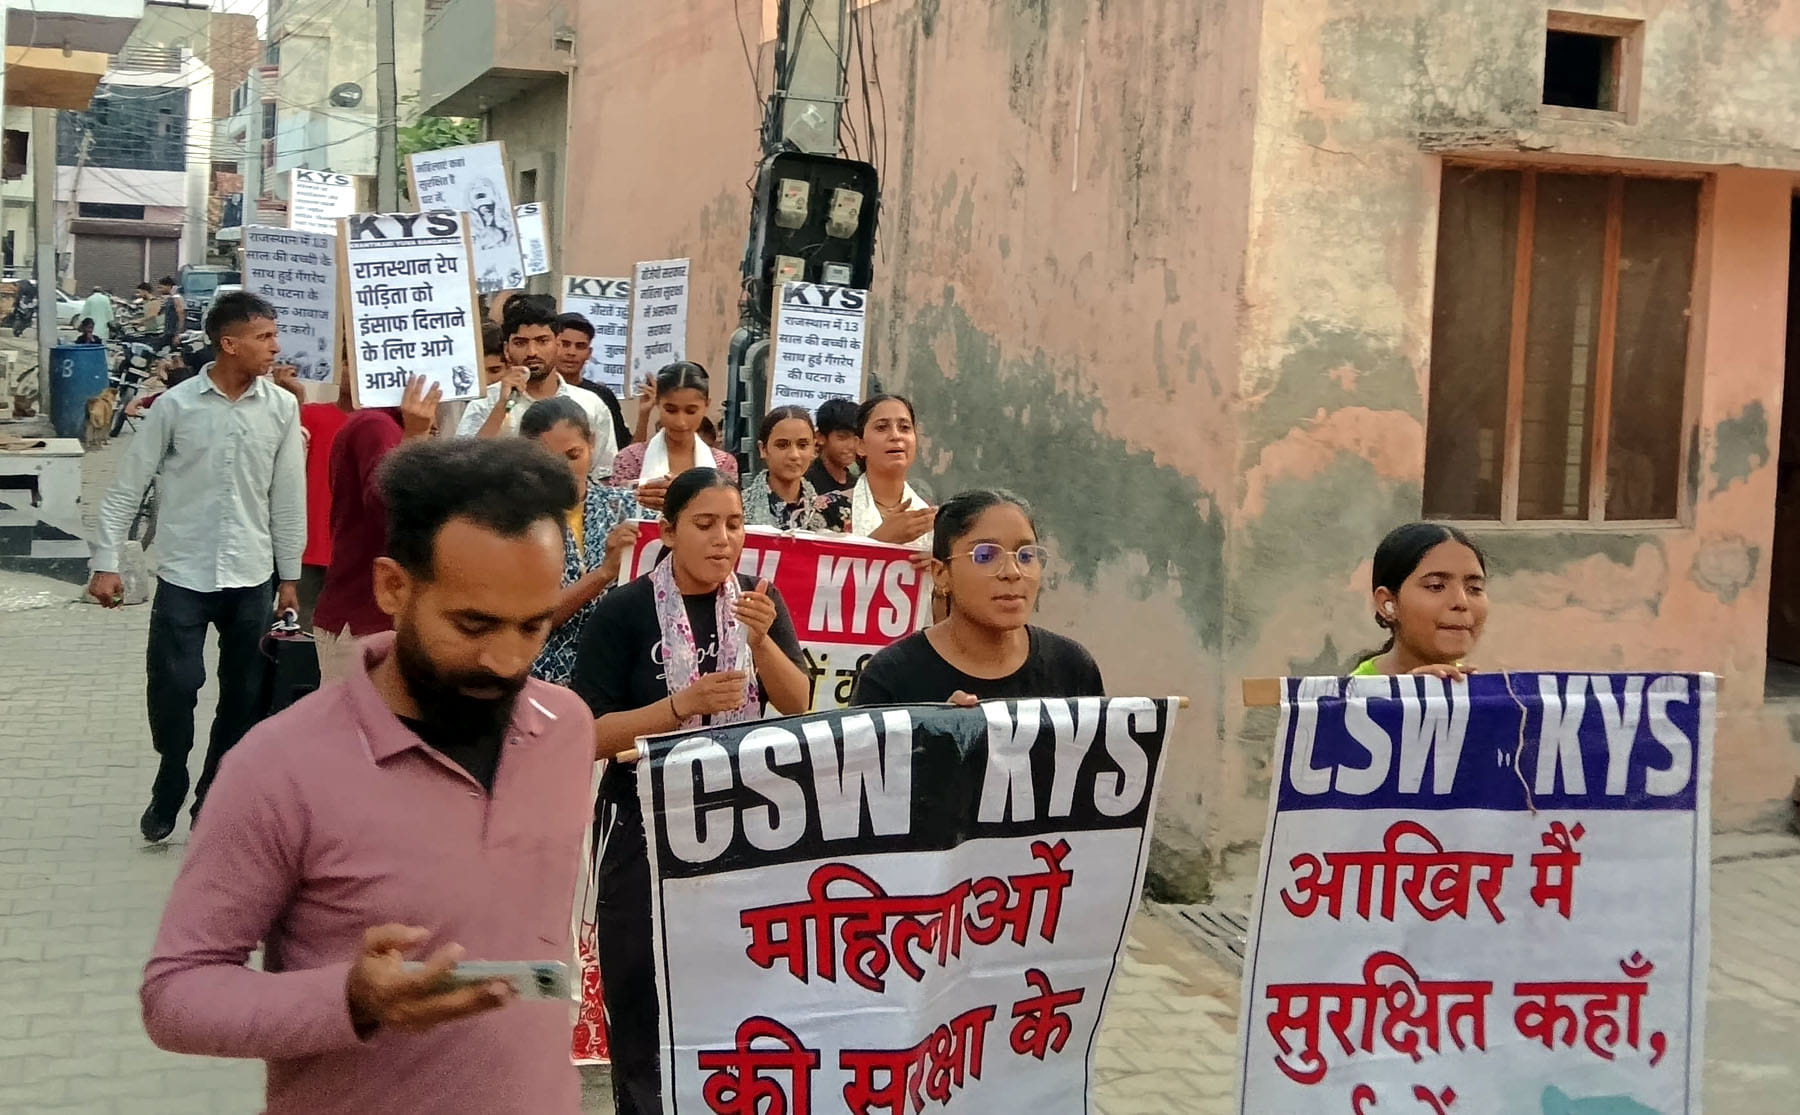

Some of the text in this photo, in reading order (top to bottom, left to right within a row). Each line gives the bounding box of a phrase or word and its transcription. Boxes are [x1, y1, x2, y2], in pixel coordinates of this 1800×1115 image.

[297, 170, 349, 185] KYS
[349, 209, 458, 240] KYS
[249, 233, 328, 249] राजस्थान में 13
[246, 250, 269, 261] साल
[272, 249, 287, 262] की
[320, 253, 332, 266] के
[353, 253, 458, 279] राजस्थान रेप
[251, 268, 275, 279] साथ
[277, 268, 292, 285] हुई
[568, 277, 631, 298] KYS
[259, 284, 319, 300] की घटना के
[355, 281, 433, 309] पीड़िता को
[783, 283, 864, 309] KYS
[358, 306, 466, 336] इंसाफ दिलाने
[784, 316, 859, 332] राजस्थान में 13
[360, 335, 454, 362] के लिए आगे
[779, 333, 861, 350] साल की बच्ची के
[782, 351, 806, 362] साथ
[807, 352, 823, 368] हुई
[365, 366, 413, 389] आओ
[787, 367, 846, 384] की घटना के
[775, 384, 815, 399] खिलाफ
[808, 555, 916, 638] KYS
[1290, 673, 1692, 797] CSW KYS
[663, 697, 1158, 863] CSW KYS
[1280, 820, 1586, 923] आखिर मैं
[739, 839, 1073, 993] महिलाओं
[1265, 950, 1667, 1085] सुरक्षित कहाँ,
[698, 1015, 821, 1115] की
[1009, 968, 1086, 1061] के
